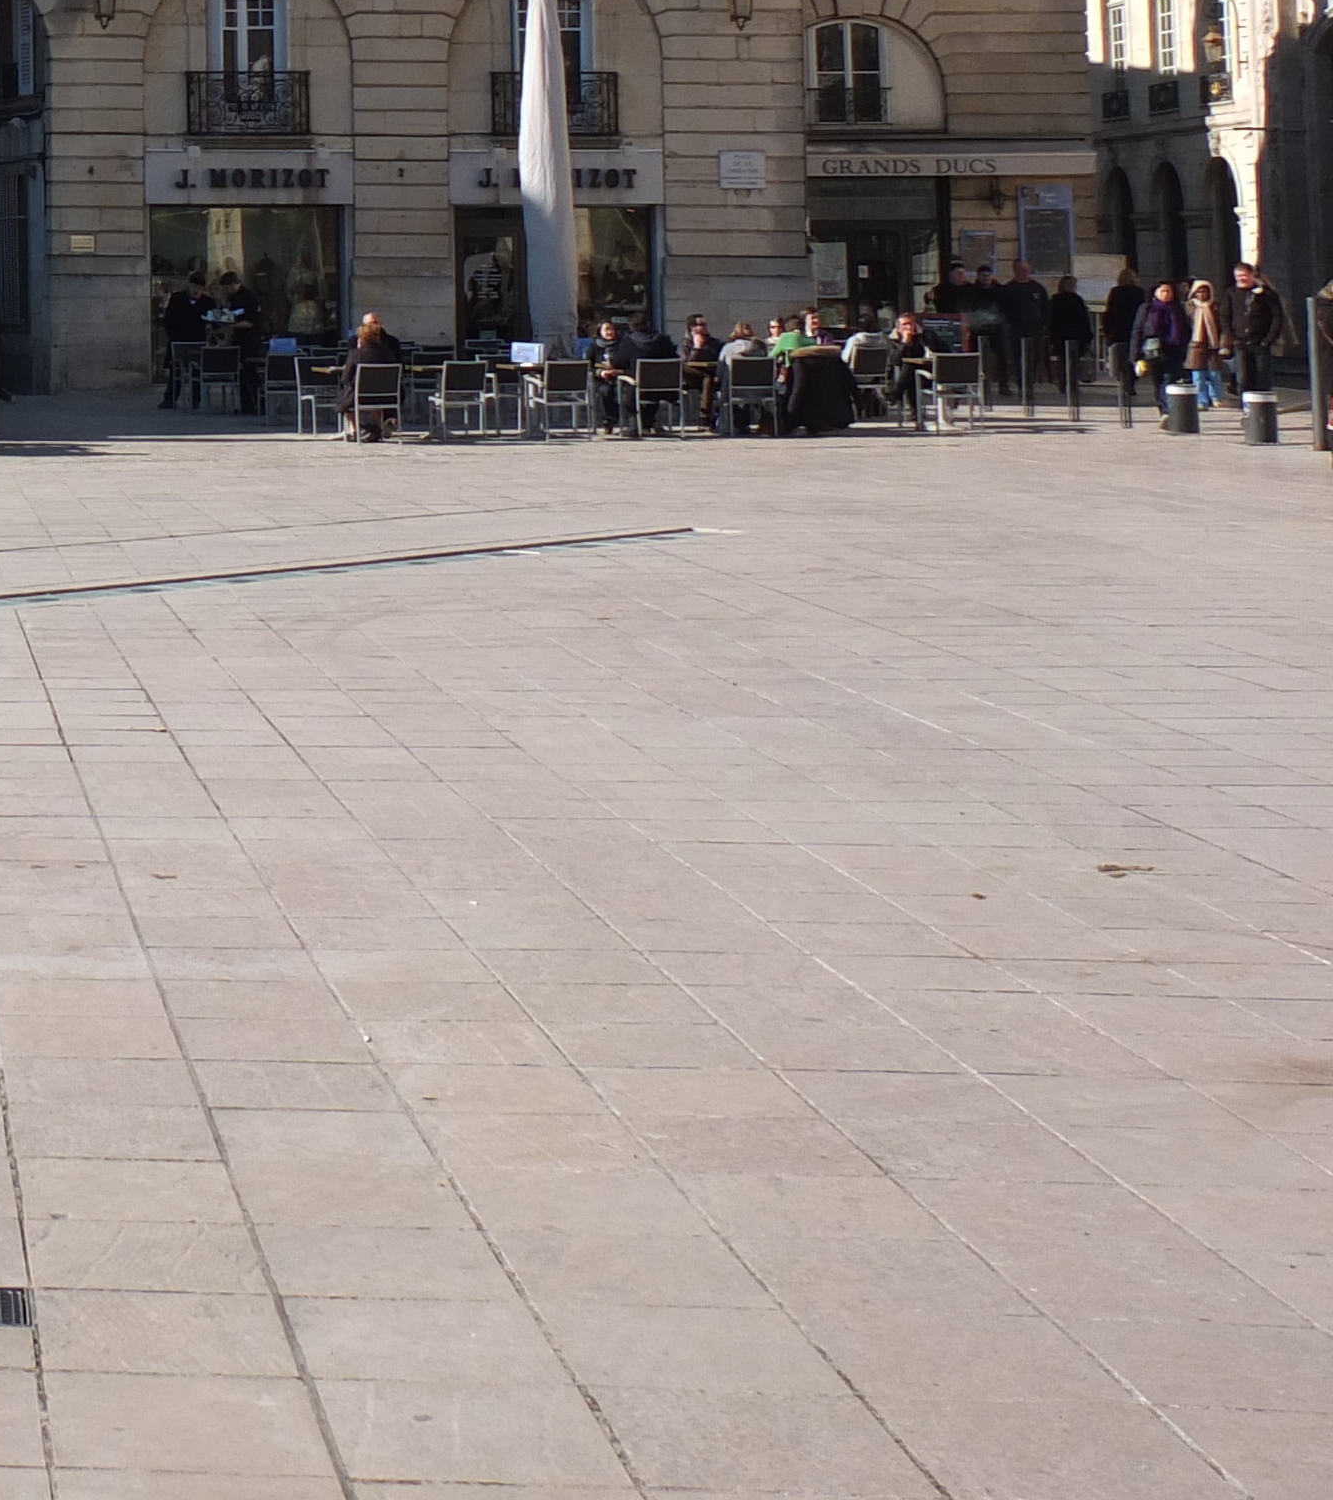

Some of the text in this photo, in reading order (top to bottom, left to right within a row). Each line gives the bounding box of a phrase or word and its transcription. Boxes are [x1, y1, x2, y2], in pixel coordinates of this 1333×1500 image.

[822, 158, 997, 174] GRANDS DUCS
[175, 168, 330, 189] J. MORIZOT
[478, 168, 499, 188] J.
